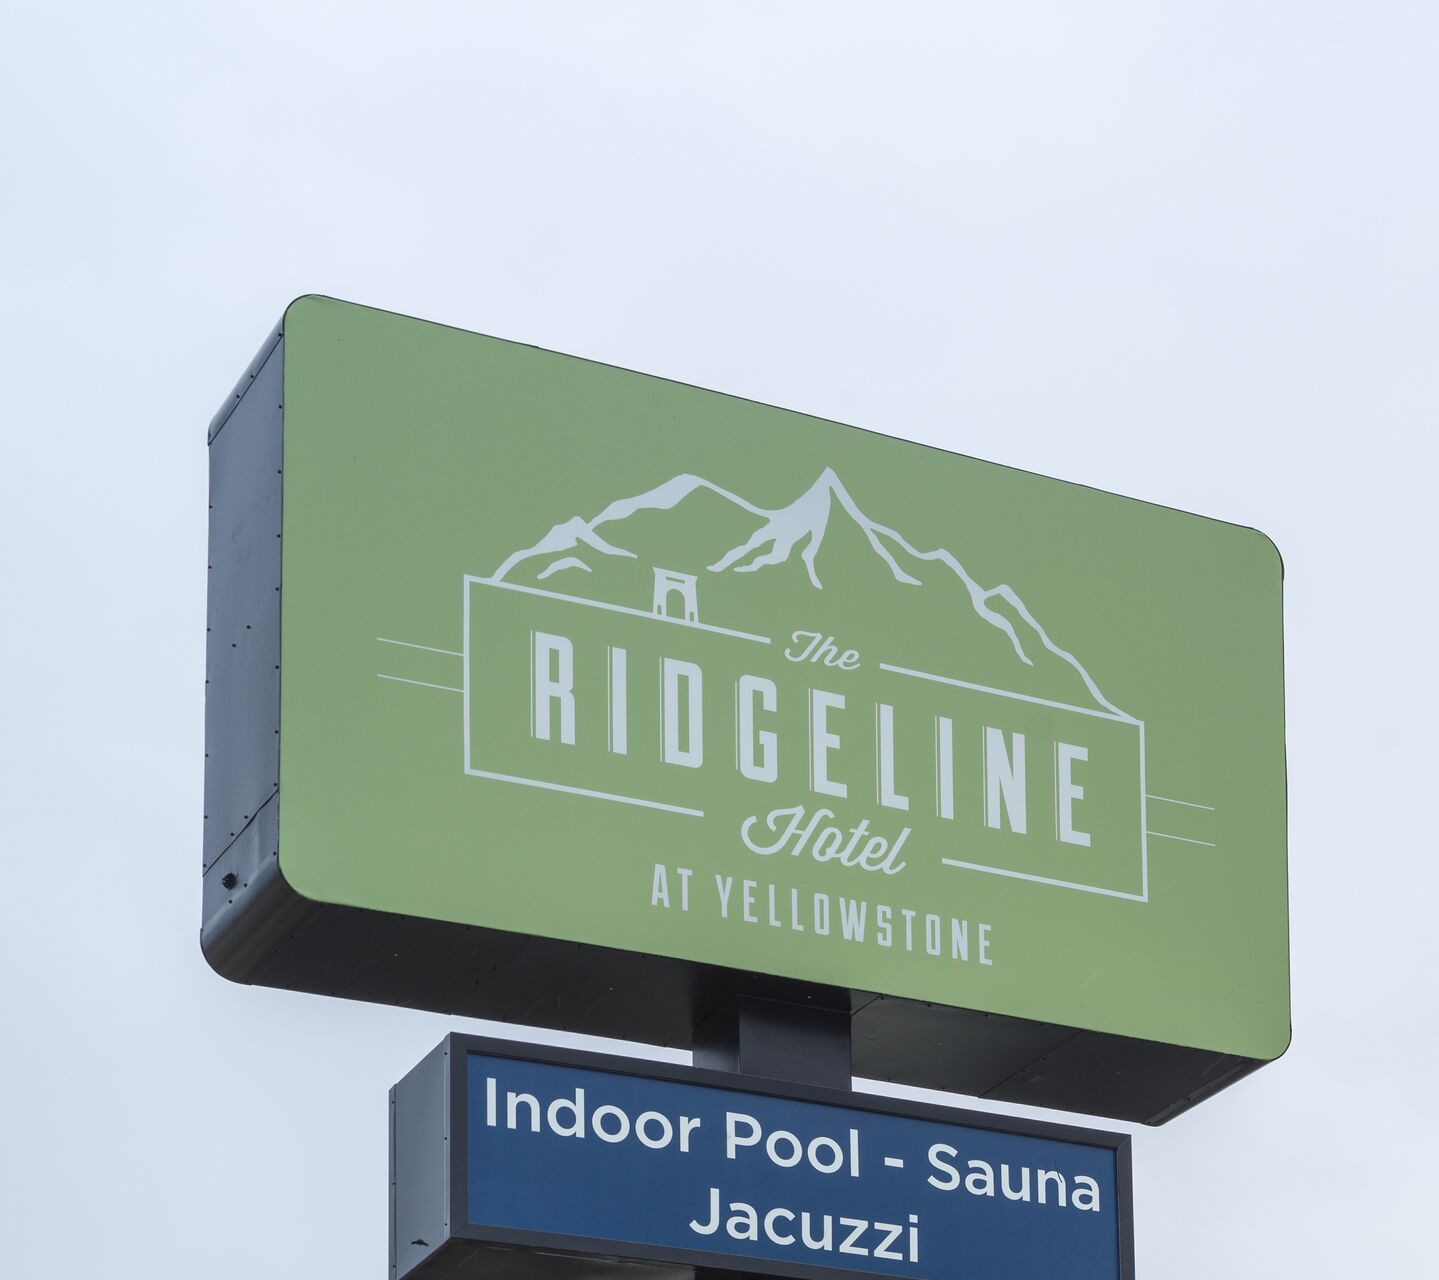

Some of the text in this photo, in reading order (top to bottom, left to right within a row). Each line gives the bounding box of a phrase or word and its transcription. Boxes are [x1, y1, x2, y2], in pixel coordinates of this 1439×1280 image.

[785, 629, 861, 672] The
[530, 628, 1092, 849] RIDGELINE
[740, 803, 912, 878] Hotel
[650, 863, 994, 967] AT YELLOWSTONE
[486, 1077, 701, 1153] Indoor
[725, 1111, 860, 1178] Pool
[927, 1143, 1101, 1212] Sauna
[688, 1187, 919, 1263] Jacuzzi
